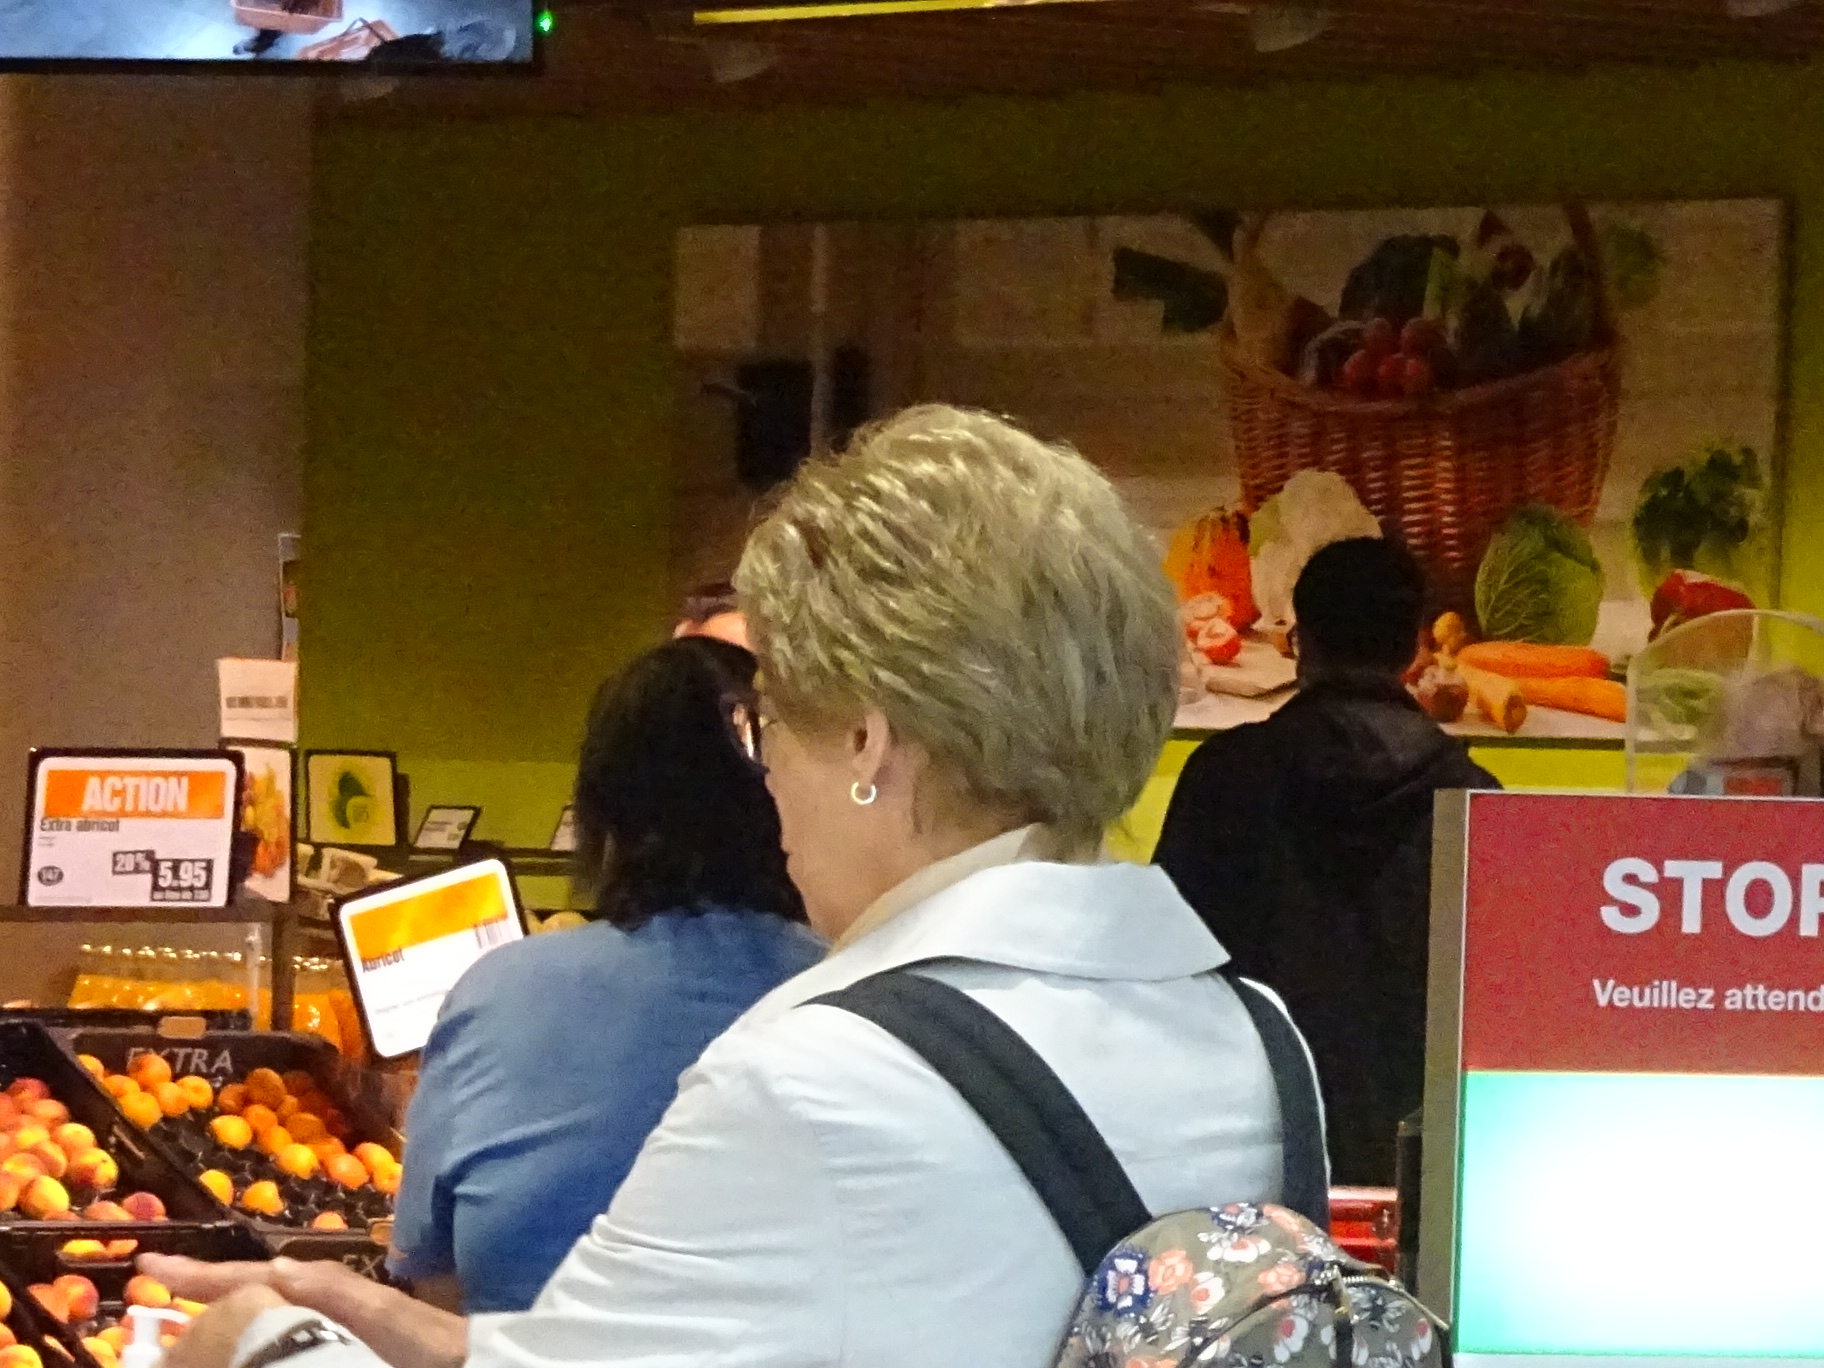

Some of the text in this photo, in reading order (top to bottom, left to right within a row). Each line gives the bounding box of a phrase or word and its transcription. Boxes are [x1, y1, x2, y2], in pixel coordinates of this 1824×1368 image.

[82, 776, 189, 812] ACTION
[40, 816, 120, 832] Extra abricot
[1592, 978, 1715, 1010] Veuillez
